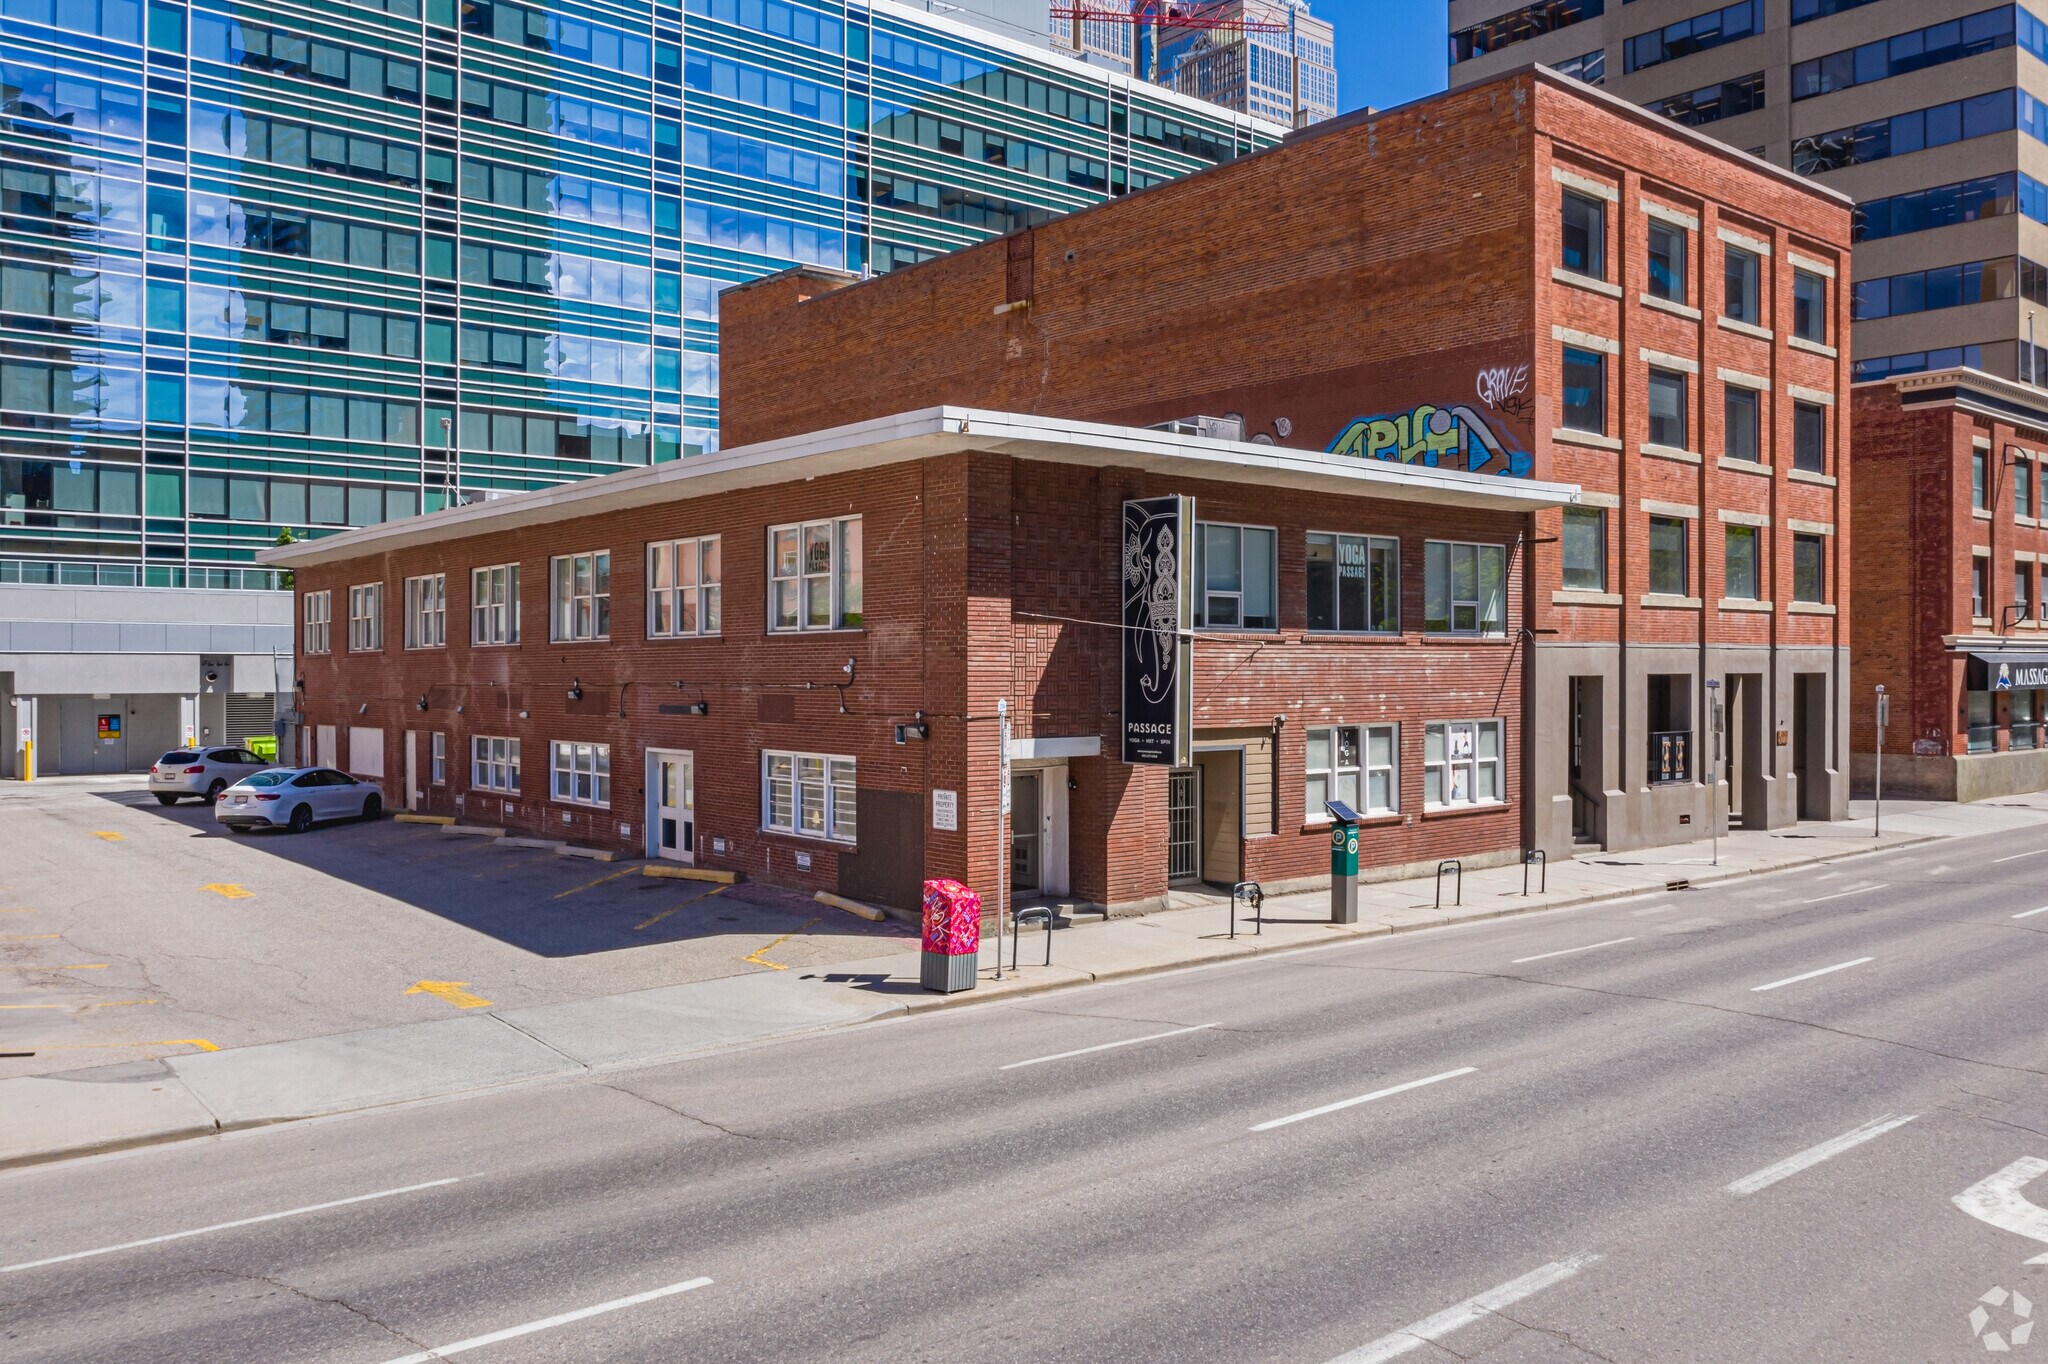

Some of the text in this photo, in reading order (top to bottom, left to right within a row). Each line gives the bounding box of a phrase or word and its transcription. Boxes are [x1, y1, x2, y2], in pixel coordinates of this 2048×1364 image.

[1477, 364, 1529, 409] GRAVE
[809, 541, 830, 560] YOGA
[1339, 544, 1366, 565] YOGA
[1338, 565, 1366, 578] PASSAGE
[2015, 668, 2048, 686] MASSAG
[1128, 722, 1172, 735] PASSAGE
[937, 793, 952, 801] PRIVATE
[935, 801, 954, 809] PROPERTY
[1335, 832, 1342, 842] P
[1350, 841, 1356, 851] P
